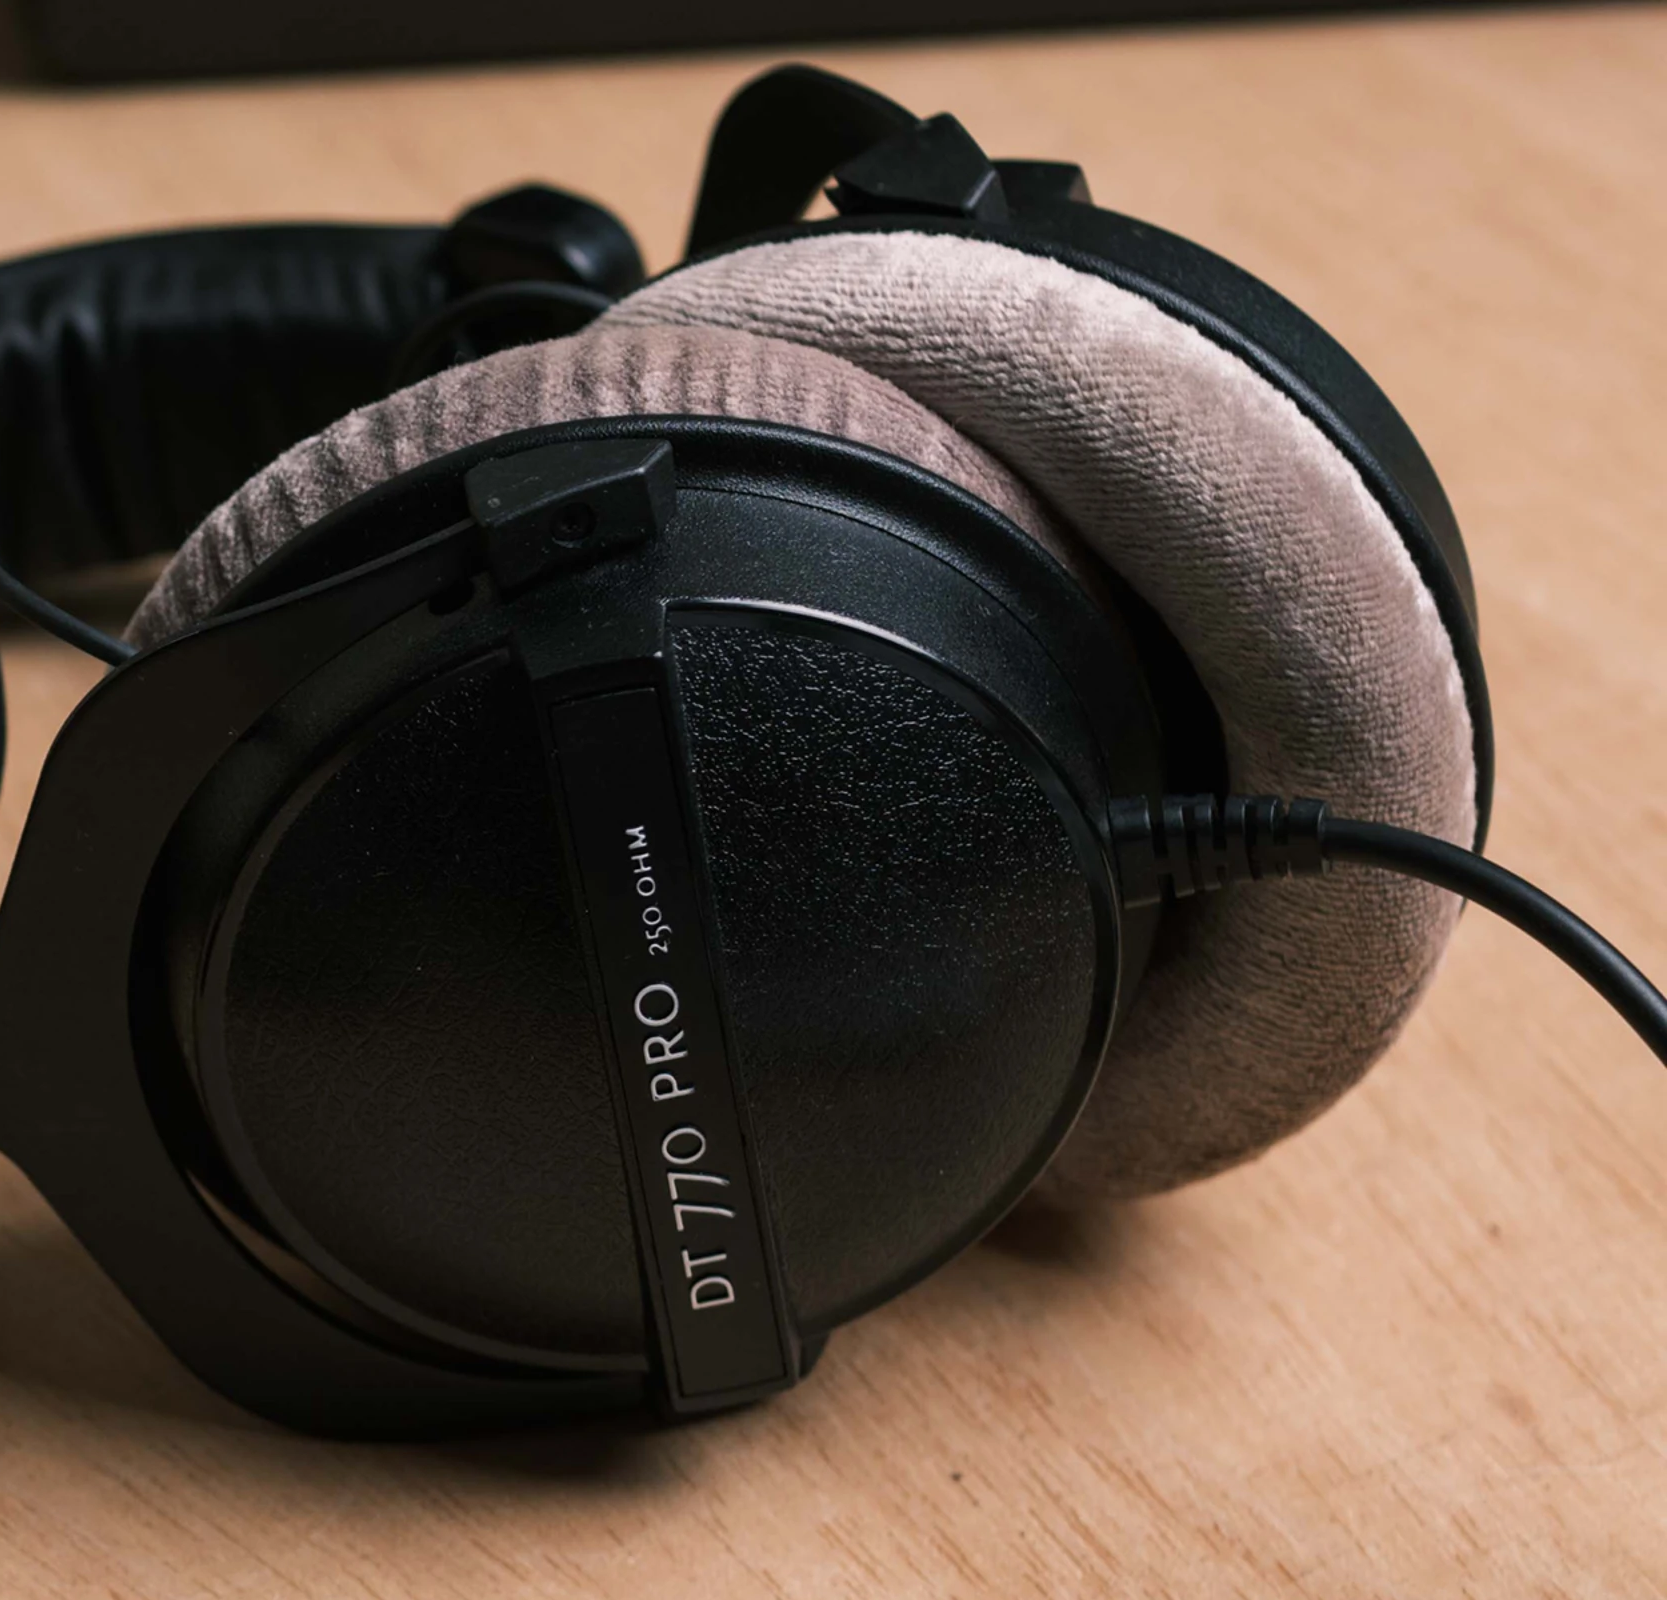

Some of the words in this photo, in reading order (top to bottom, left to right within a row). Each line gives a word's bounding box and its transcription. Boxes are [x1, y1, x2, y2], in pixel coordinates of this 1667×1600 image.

[625, 824, 658, 898] OHM
[642, 905, 673, 956] 250
[633, 982, 695, 1102] PRO
[661, 1126, 736, 1233] 770
[681, 1249, 736, 1310] DT
